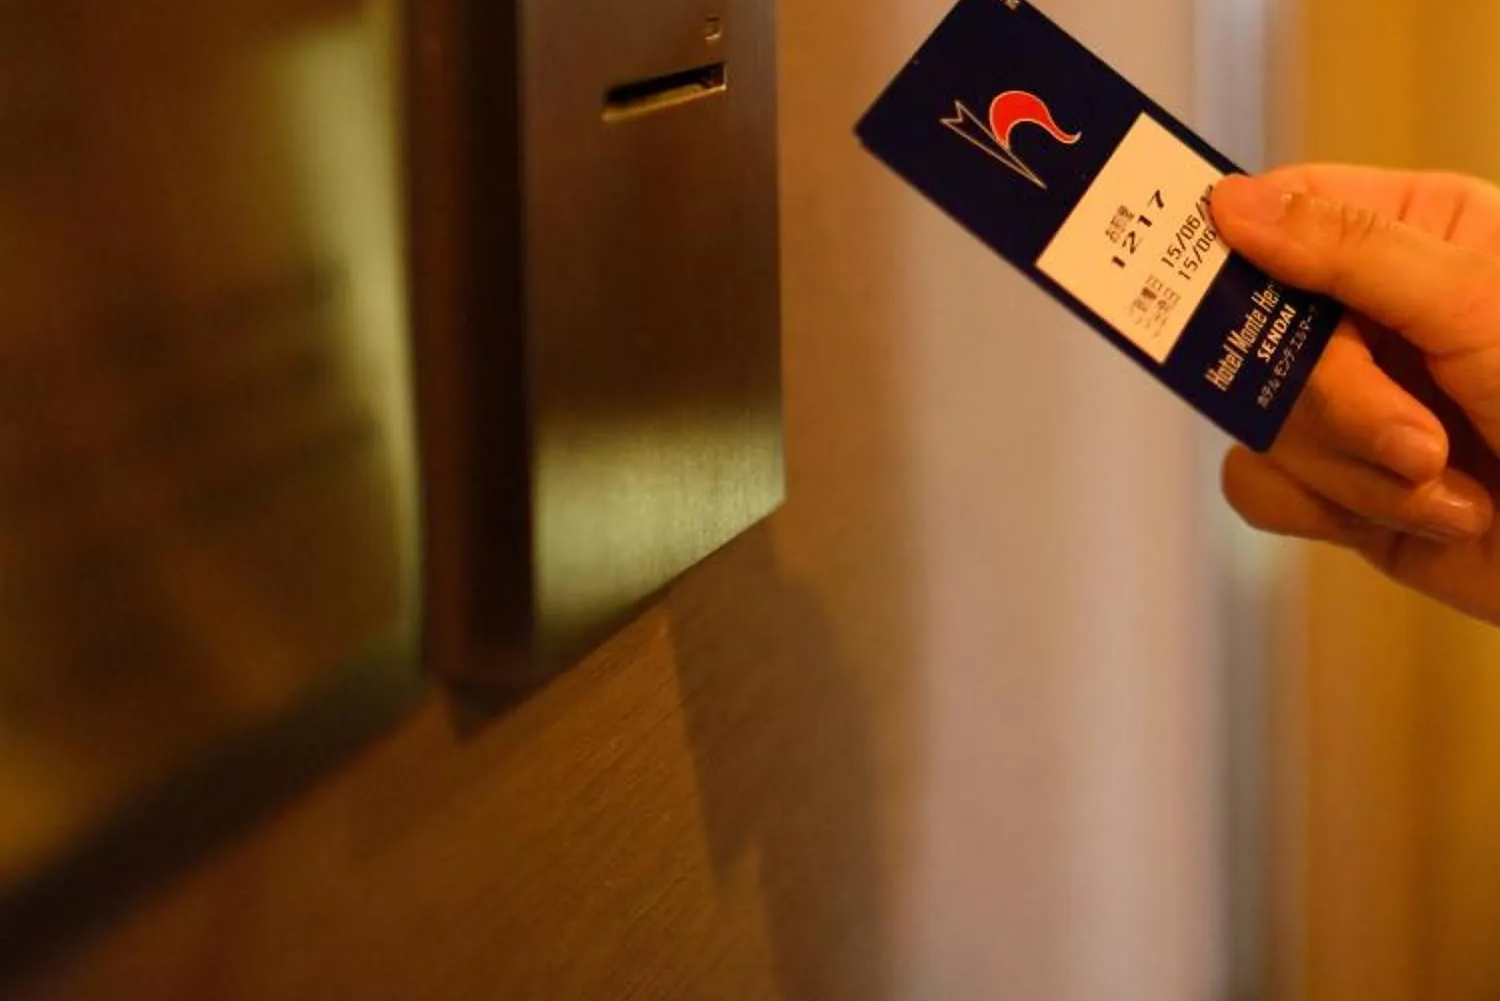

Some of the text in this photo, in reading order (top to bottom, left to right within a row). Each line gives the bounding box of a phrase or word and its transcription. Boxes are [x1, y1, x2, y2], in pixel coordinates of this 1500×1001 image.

[1112, 189, 1164, 269] 1217
[1178, 228, 1217, 280] 15/06
[1204, 282, 1281, 392] Hotel Monte Her
[1257, 303, 1297, 363] SENDAI
